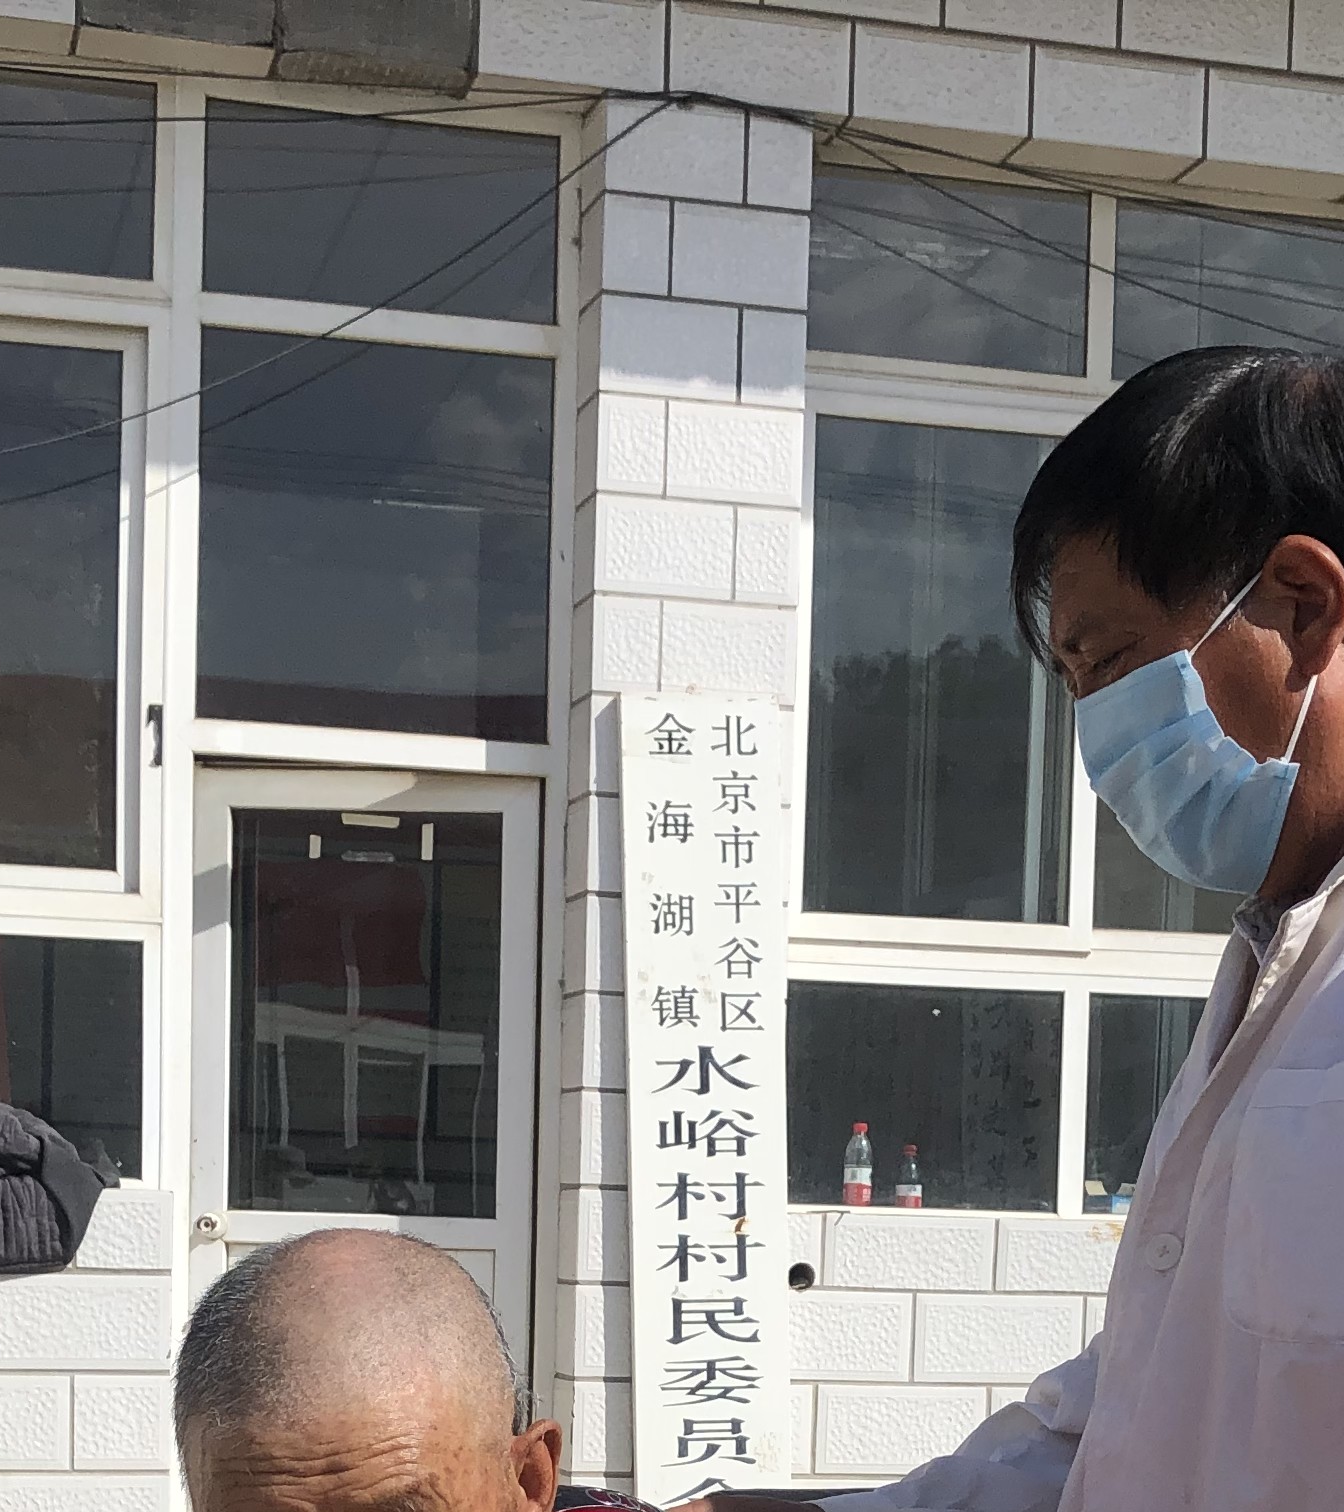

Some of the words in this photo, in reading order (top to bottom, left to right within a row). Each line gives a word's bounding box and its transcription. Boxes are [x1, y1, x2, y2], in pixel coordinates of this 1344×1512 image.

[644, 712, 701, 1029] 金海湖镇
[710, 714, 765, 1033] 北京市平谷区
